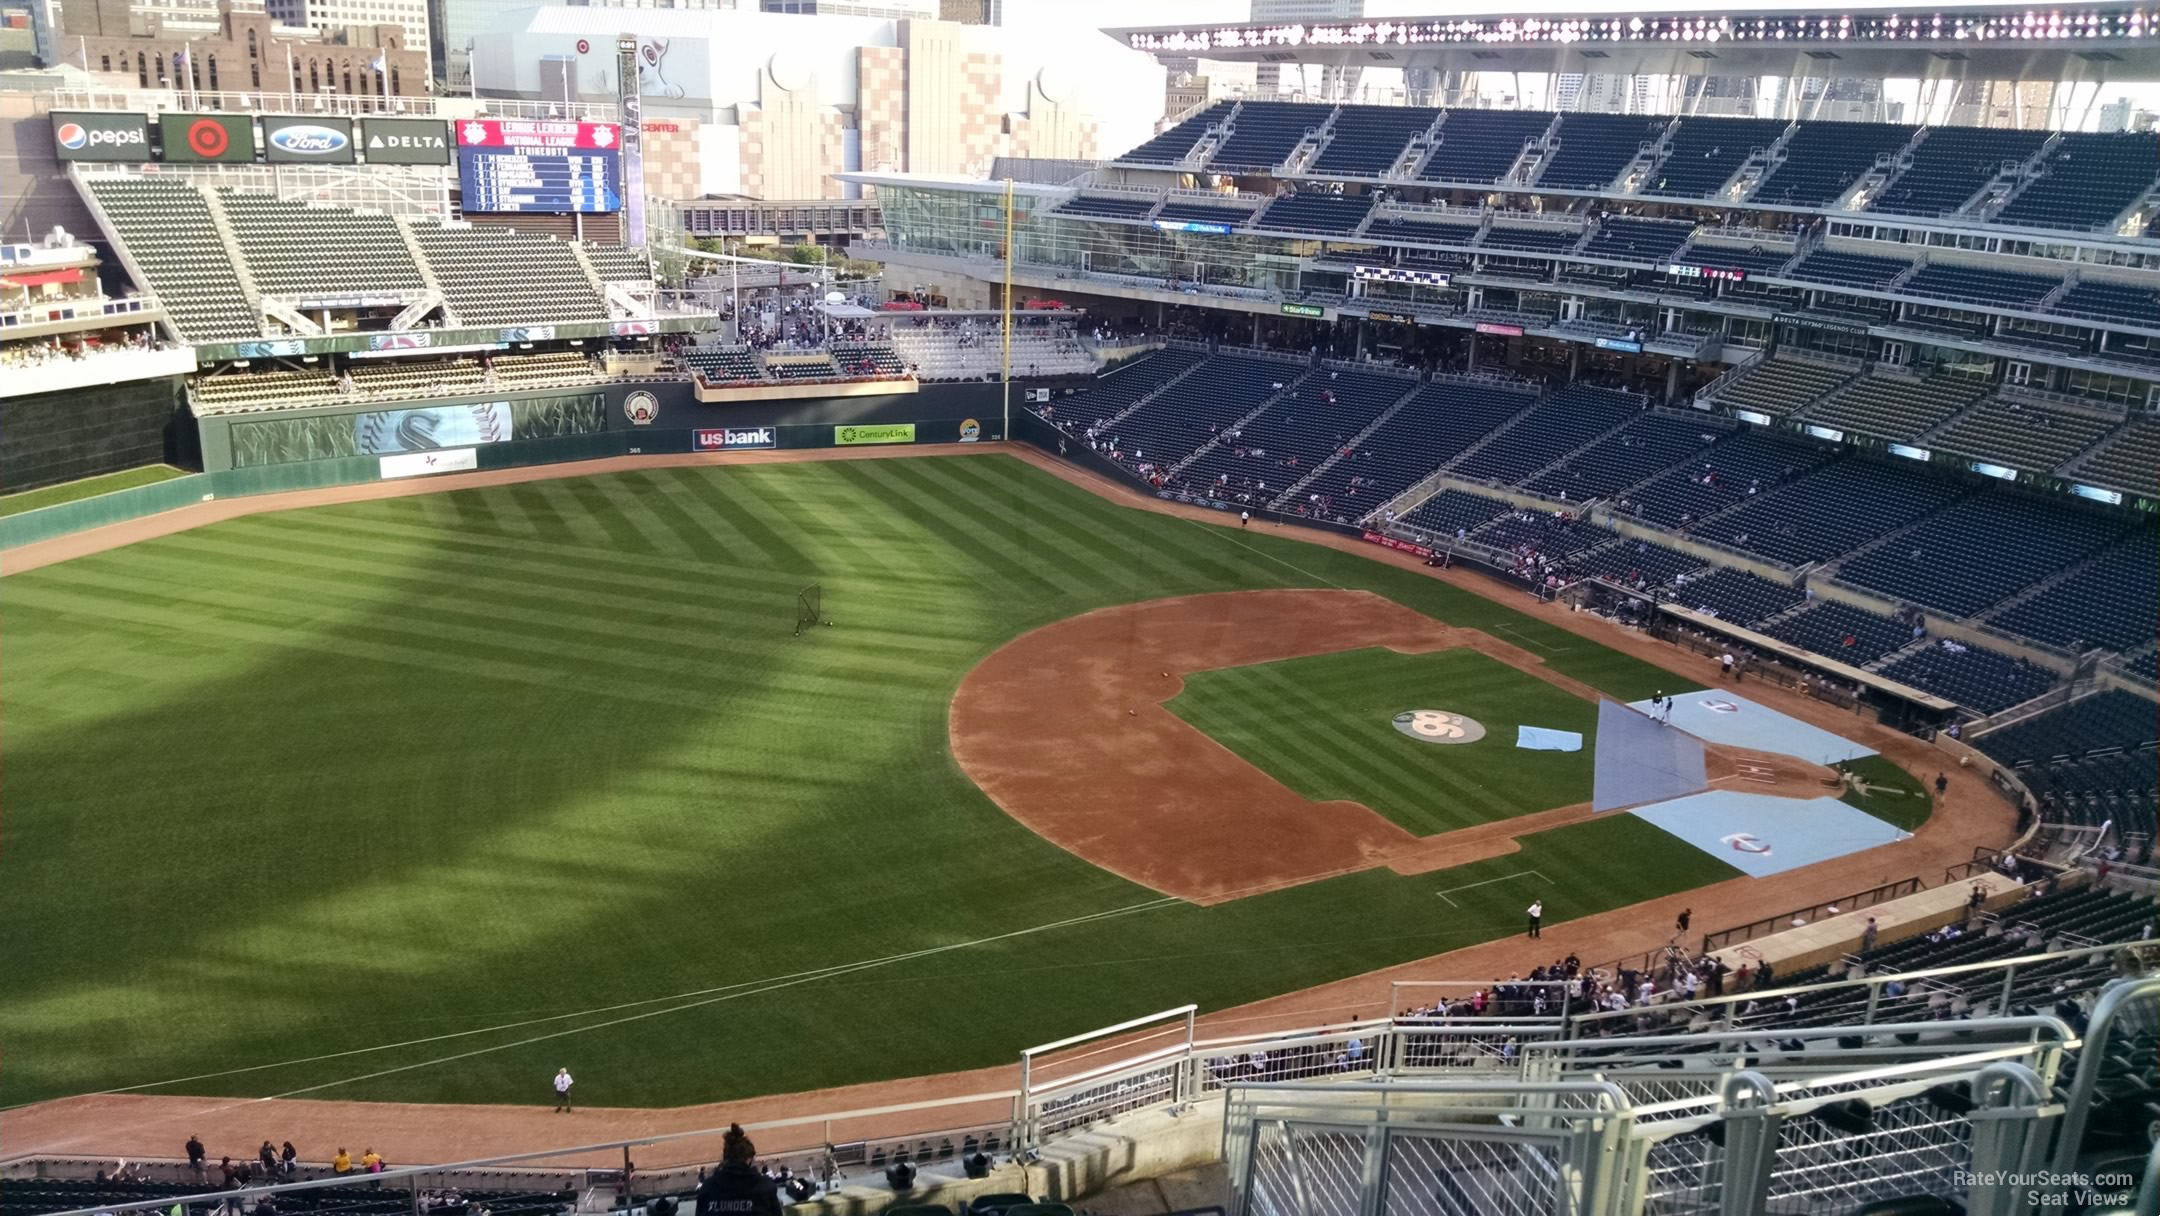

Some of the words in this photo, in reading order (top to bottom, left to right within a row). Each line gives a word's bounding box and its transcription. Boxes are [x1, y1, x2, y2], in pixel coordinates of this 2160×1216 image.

[641, 123, 679, 133] CENTER
[89, 128, 145, 147] pepsi
[286, 131, 332, 149] Ford
[388, 135, 445, 148] DELTA
[1780, 316, 1800, 325] DELTA
[1823, 323, 1849, 333] LEGENDS
[1849, 327, 1865, 335] CLUB
[859, 429, 909, 440] CenturyLink
